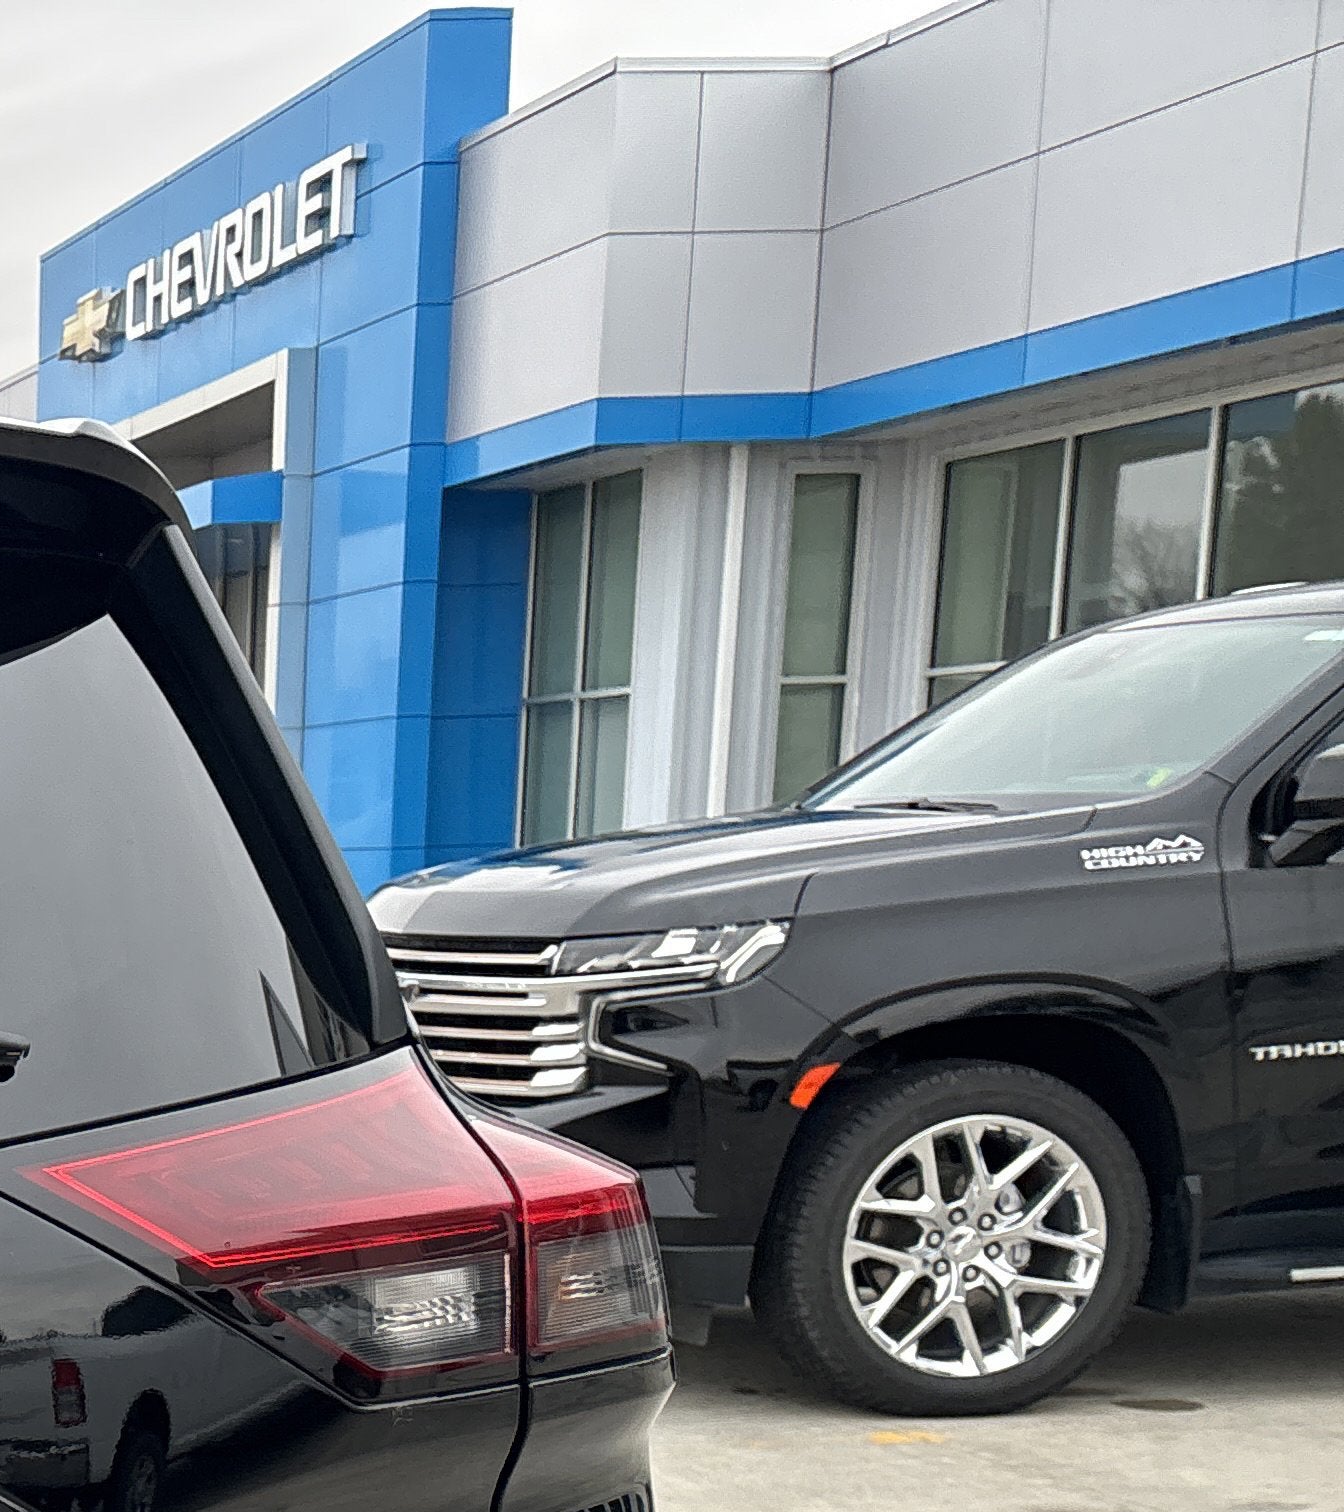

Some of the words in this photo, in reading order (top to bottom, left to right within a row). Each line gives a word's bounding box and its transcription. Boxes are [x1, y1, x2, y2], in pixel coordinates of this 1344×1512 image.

[125, 144, 367, 340] CHEVROLET
[1080, 845, 1145, 859] HIGH
[1084, 851, 1203, 870] COUNTRY
[1249, 1040, 1344, 1062] TAHO
